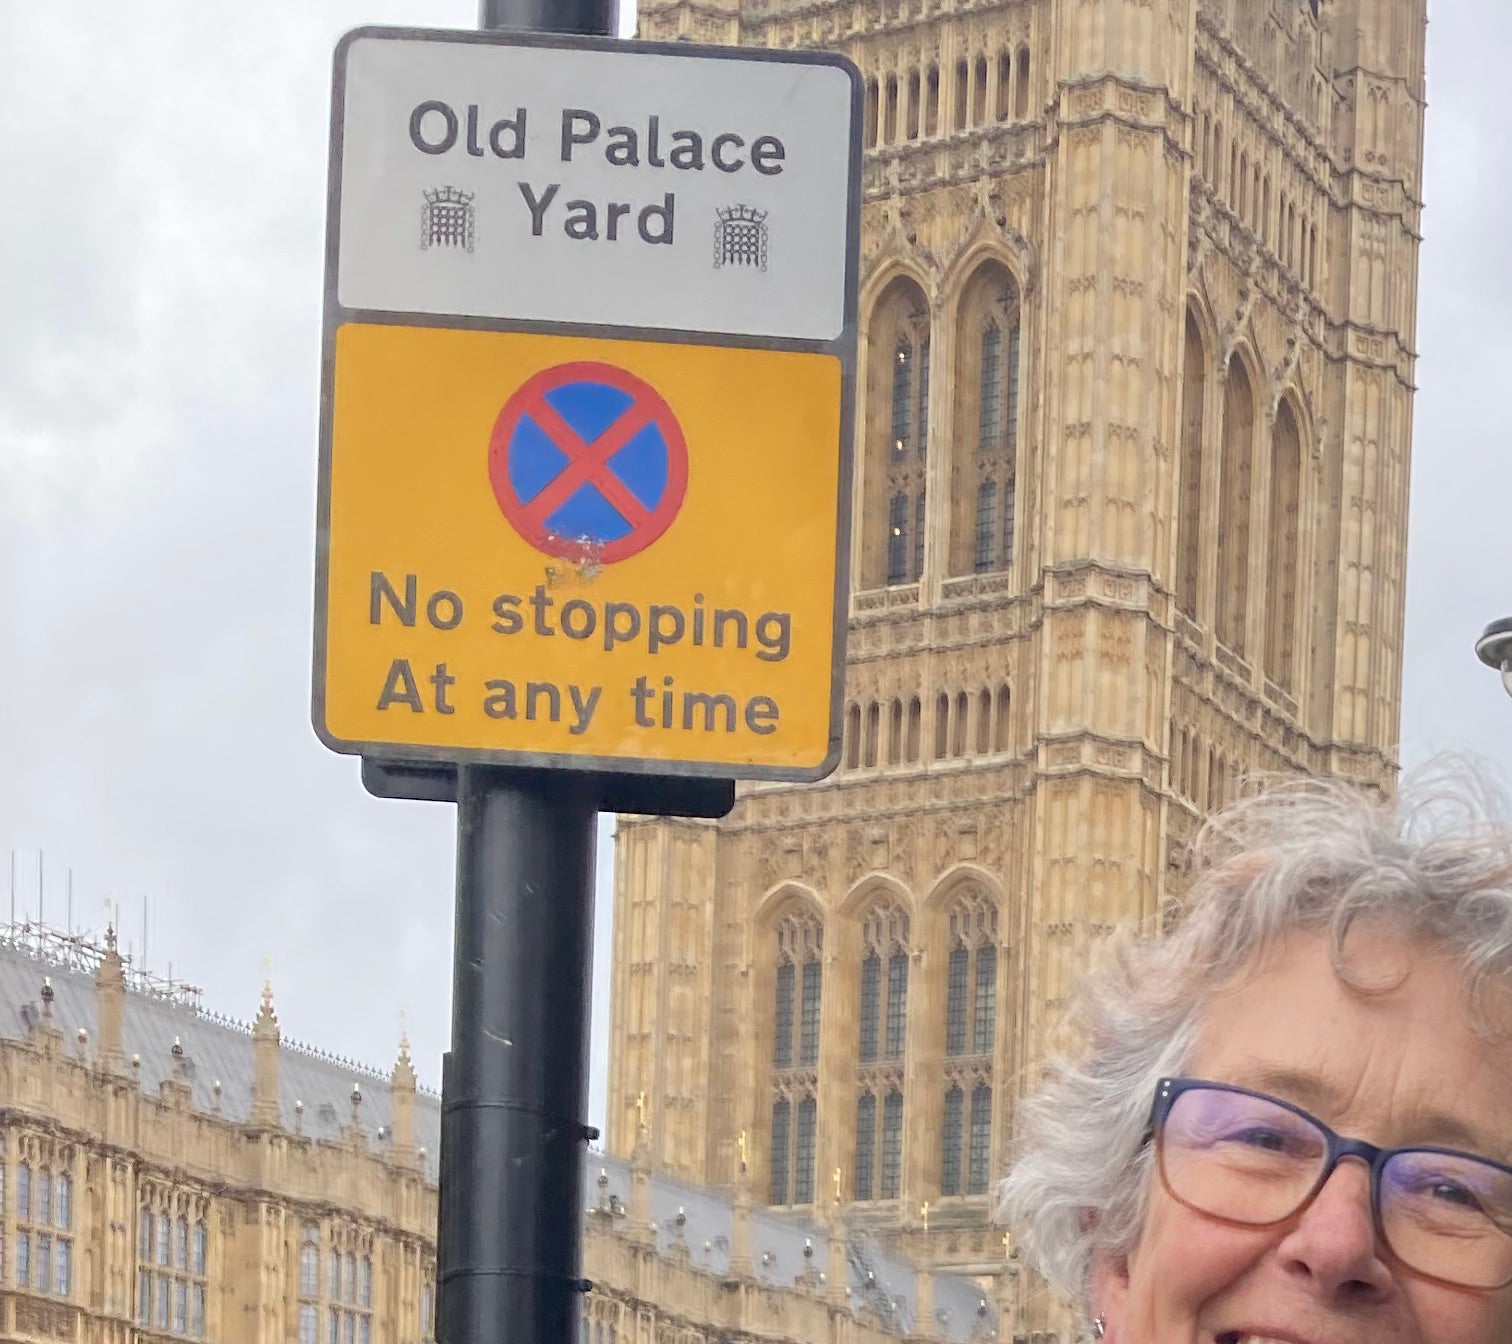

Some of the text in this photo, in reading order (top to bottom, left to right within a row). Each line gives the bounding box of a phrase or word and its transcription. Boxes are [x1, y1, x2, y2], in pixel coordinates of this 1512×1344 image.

[408, 101, 786, 176] Old Palace
[517, 182, 677, 245] Yard
[368, 570, 793, 662] No stopping
[375, 658, 781, 736] At any time
